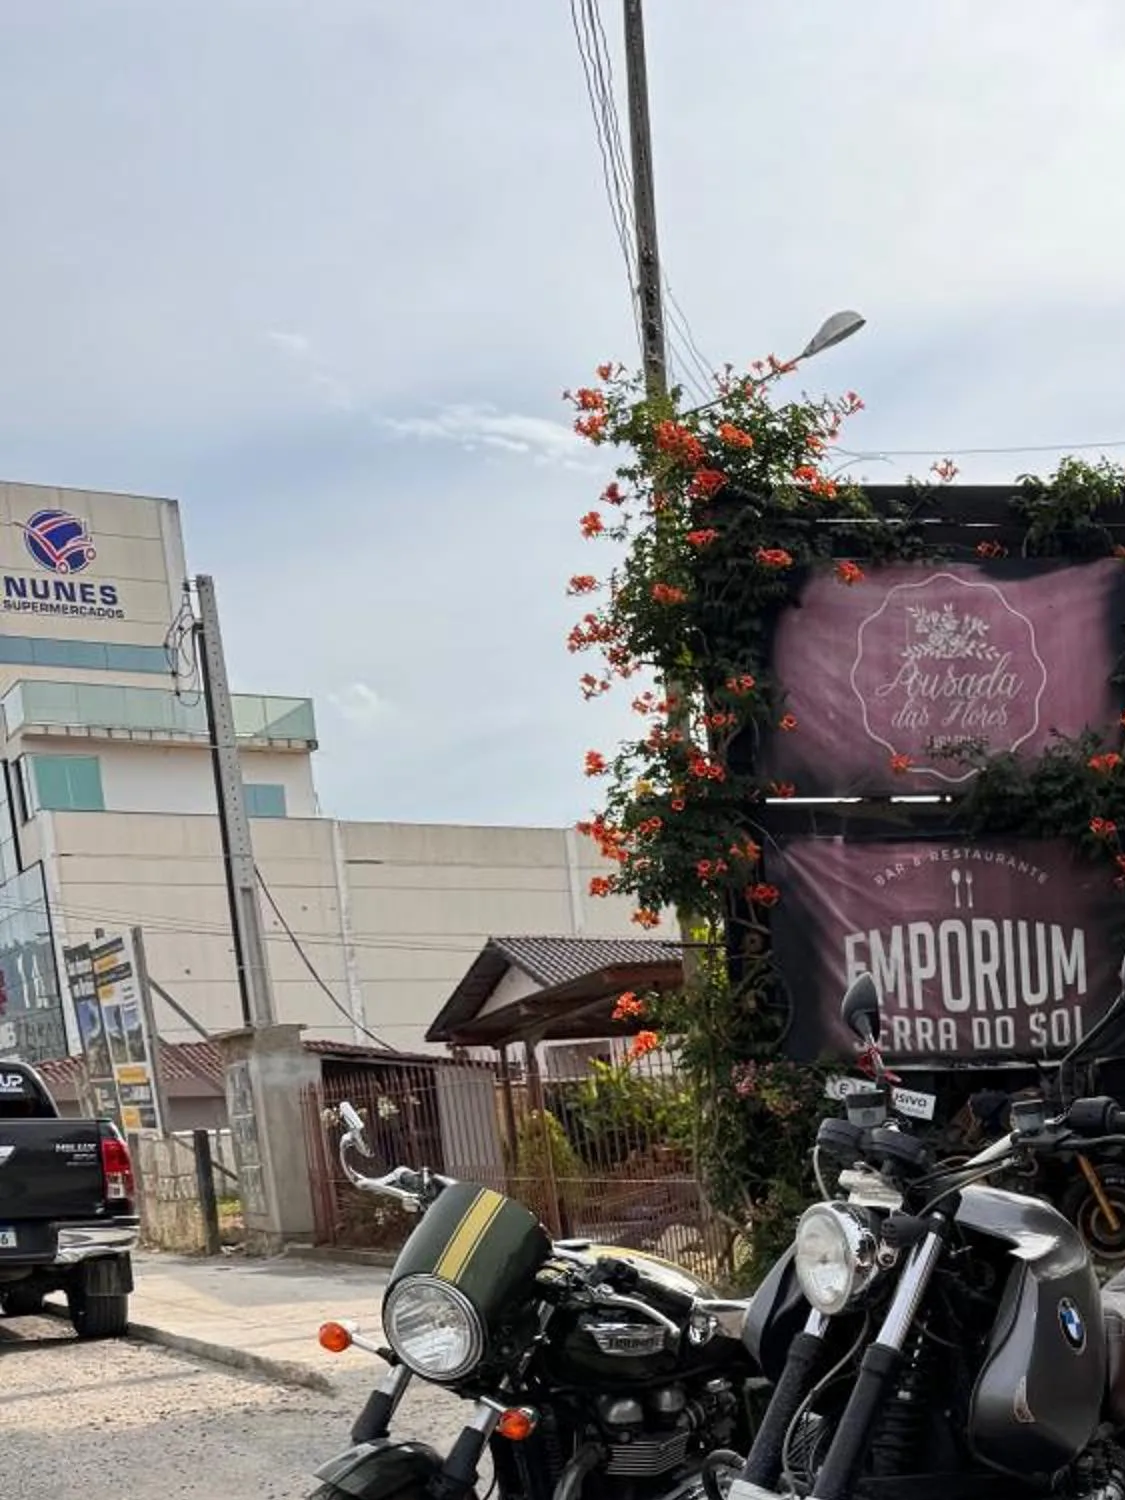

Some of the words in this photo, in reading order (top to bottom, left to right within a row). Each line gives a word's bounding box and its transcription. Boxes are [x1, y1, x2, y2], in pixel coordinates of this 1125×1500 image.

[3, 599, 125, 618] SUPERMERCADOS
[4, 576, 118, 605] NUNES
[875, 651, 1024, 701] Pousada
[891, 700, 929, 728] das
[941, 698, 1009, 729] Flores
[874, 863, 905, 886] BAR
[929, 848, 1049, 885] RESTAURANTE
[844, 918, 1088, 1013] EMPORIUM
[853, 1013, 958, 1051] ERRA
[972, 1016, 1016, 1050] DO
